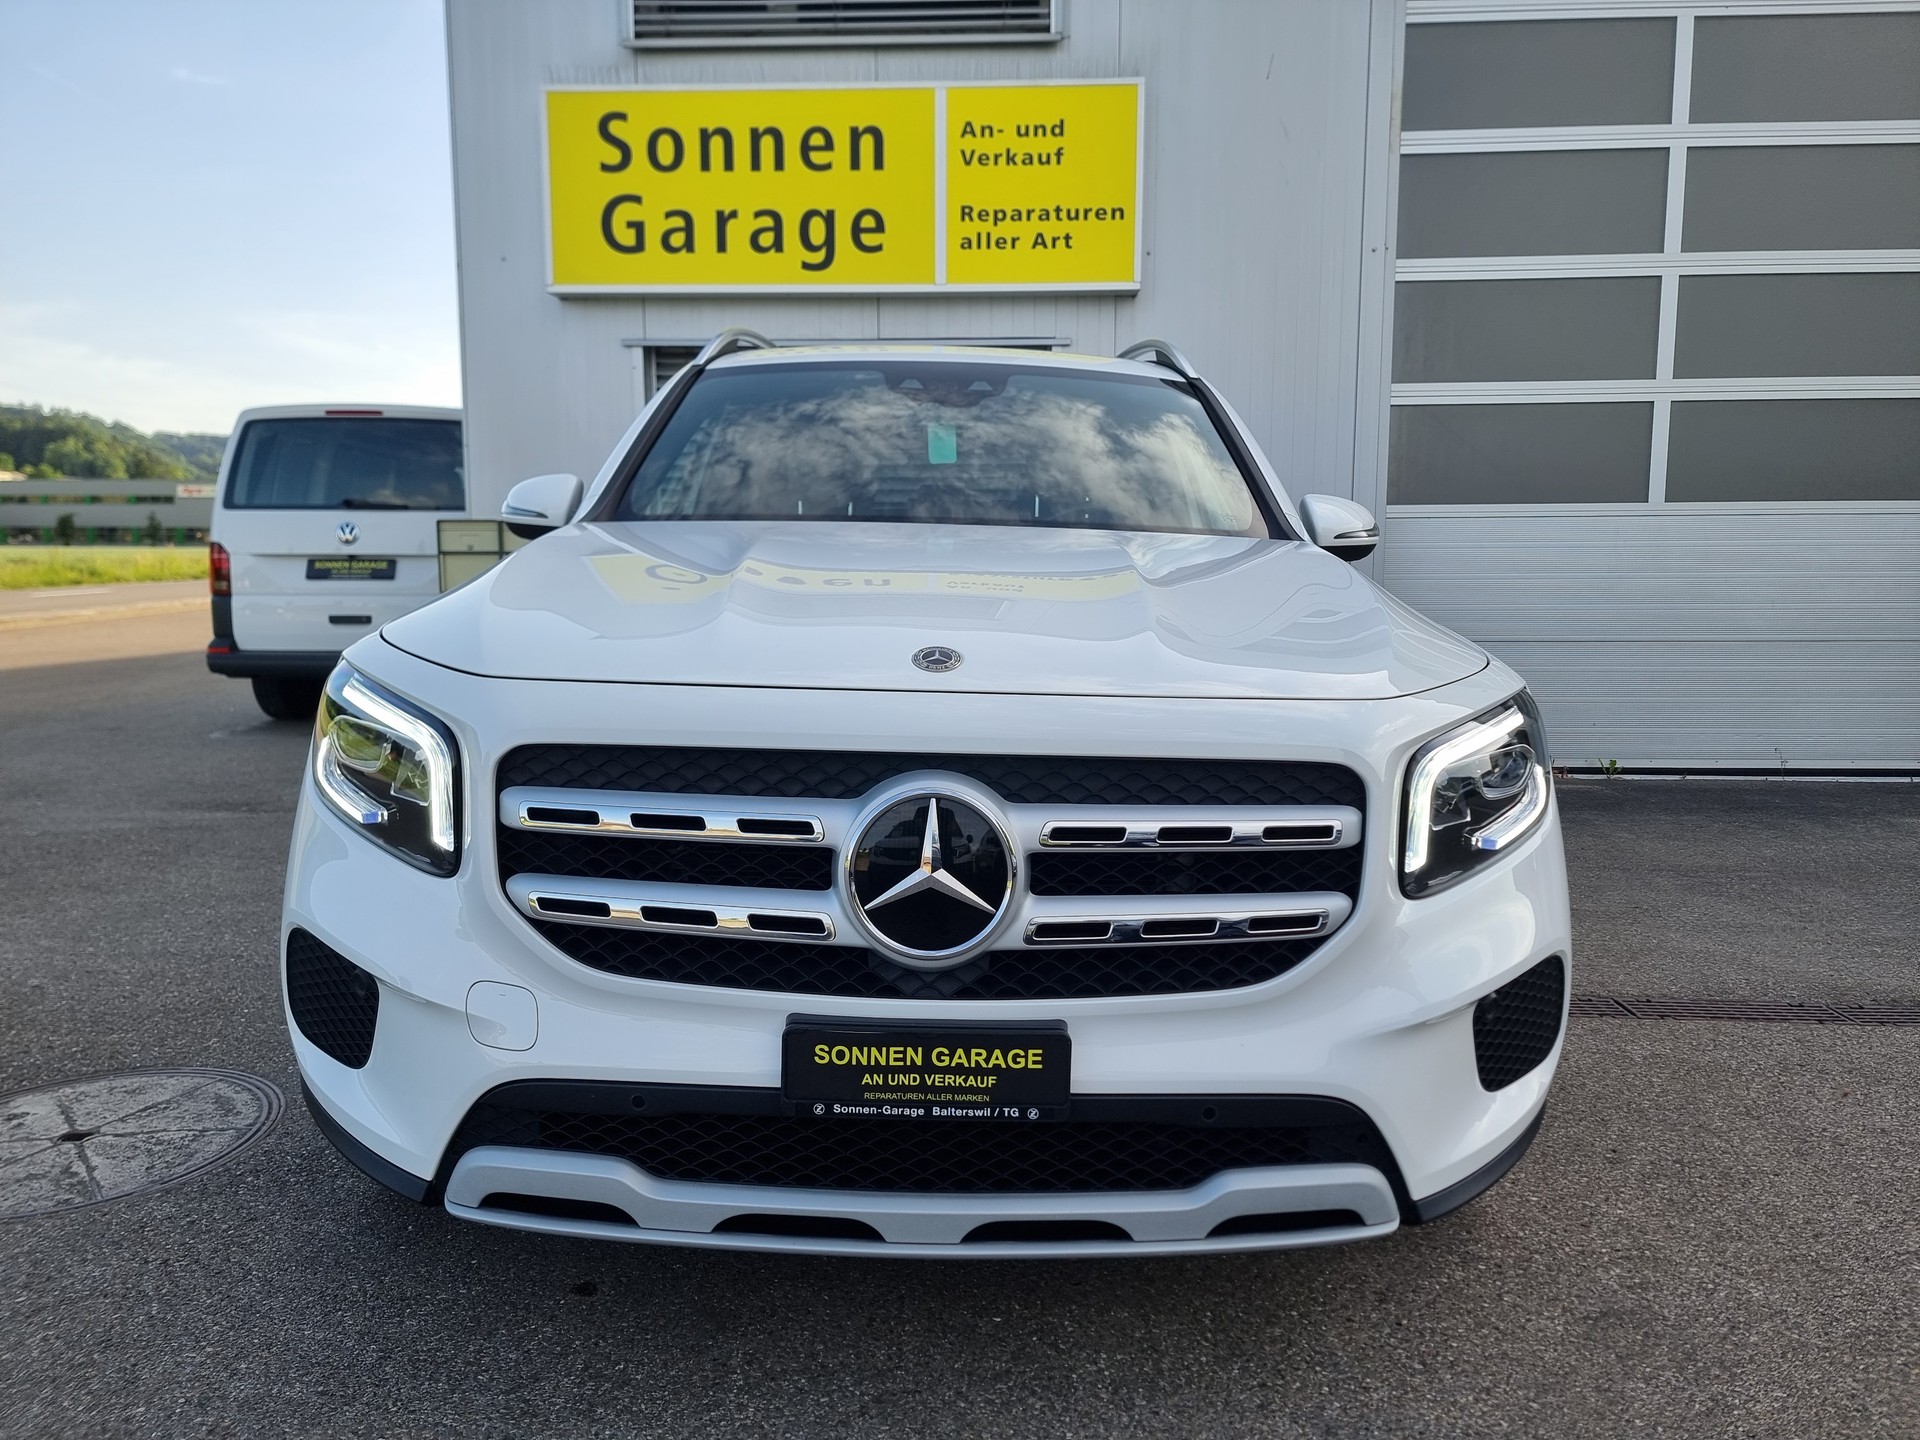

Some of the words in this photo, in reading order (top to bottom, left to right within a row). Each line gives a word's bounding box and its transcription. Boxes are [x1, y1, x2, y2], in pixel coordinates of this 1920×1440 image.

[960, 120, 1004, 138] An-
[1015, 118, 1065, 138] und
[597, 111, 885, 173] Sonnen
[960, 147, 1064, 167] Verkauf
[960, 204, 1125, 227] Reparaturen
[600, 194, 886, 272] Garage
[960, 231, 1020, 250] aller
[1031, 232, 1073, 250] Art
[813, 1044, 923, 1067] SONNEN
[931, 1047, 1043, 1069] GARAGE
[861, 1073, 883, 1086] AN
[888, 1074, 920, 1086] UND
[924, 1074, 997, 1088] VERKAUF
[864, 1092, 925, 1100] REPARATUREN
[926, 1093, 953, 1101] ALLER
[954, 1094, 990, 1102] MARKEN
[833, 1103, 925, 1118] Sonnen-Garage
[932, 1106, 991, 1117] Balterswil
[993, 1107, 1000, 1117] /
[1002, 1107, 1020, 1118] TG
